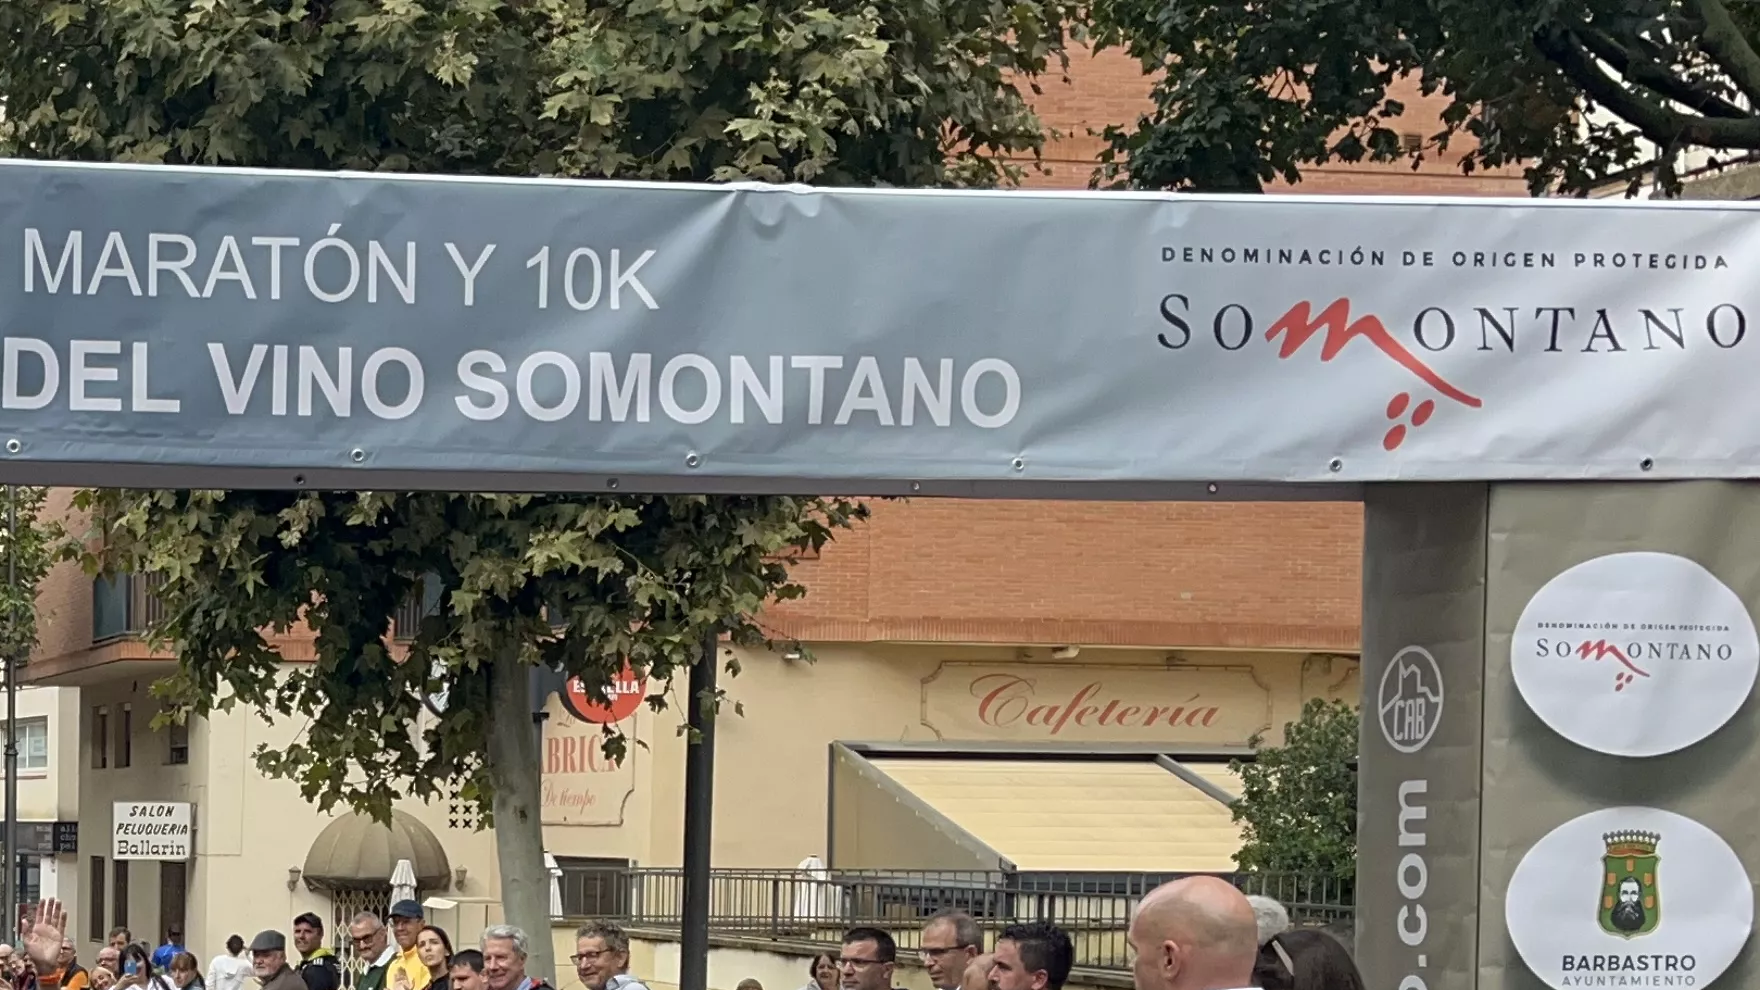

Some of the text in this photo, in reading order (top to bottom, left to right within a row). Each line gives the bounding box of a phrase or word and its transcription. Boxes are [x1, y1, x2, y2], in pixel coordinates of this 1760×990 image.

[24, 222, 417, 305] MARATÓN
[444, 243, 497, 306] Y
[526, 245, 659, 311] 10K
[1161, 246, 1730, 270] DENOMINACIÓN DE ORIGEN PROTEGIDA
[1157, 293, 1747, 408] SOMONTANO
[2, 336, 180, 414] DEL
[207, 342, 424, 420] VINO
[454, 350, 1023, 430] SOMONTANO
[1536, 638, 1733, 677] SOMONTANO
[969, 673, 1221, 734] Cafetería
[1394, 699, 1427, 742] CAB
[129, 805, 175, 817] SALON
[116, 823, 188, 835] PELUQUERIA
[117, 840, 186, 855] Ballarin
[1562, 955, 1697, 972] BARBASTRO
[1562, 976, 1696, 987] AYUNTAMIENTO
